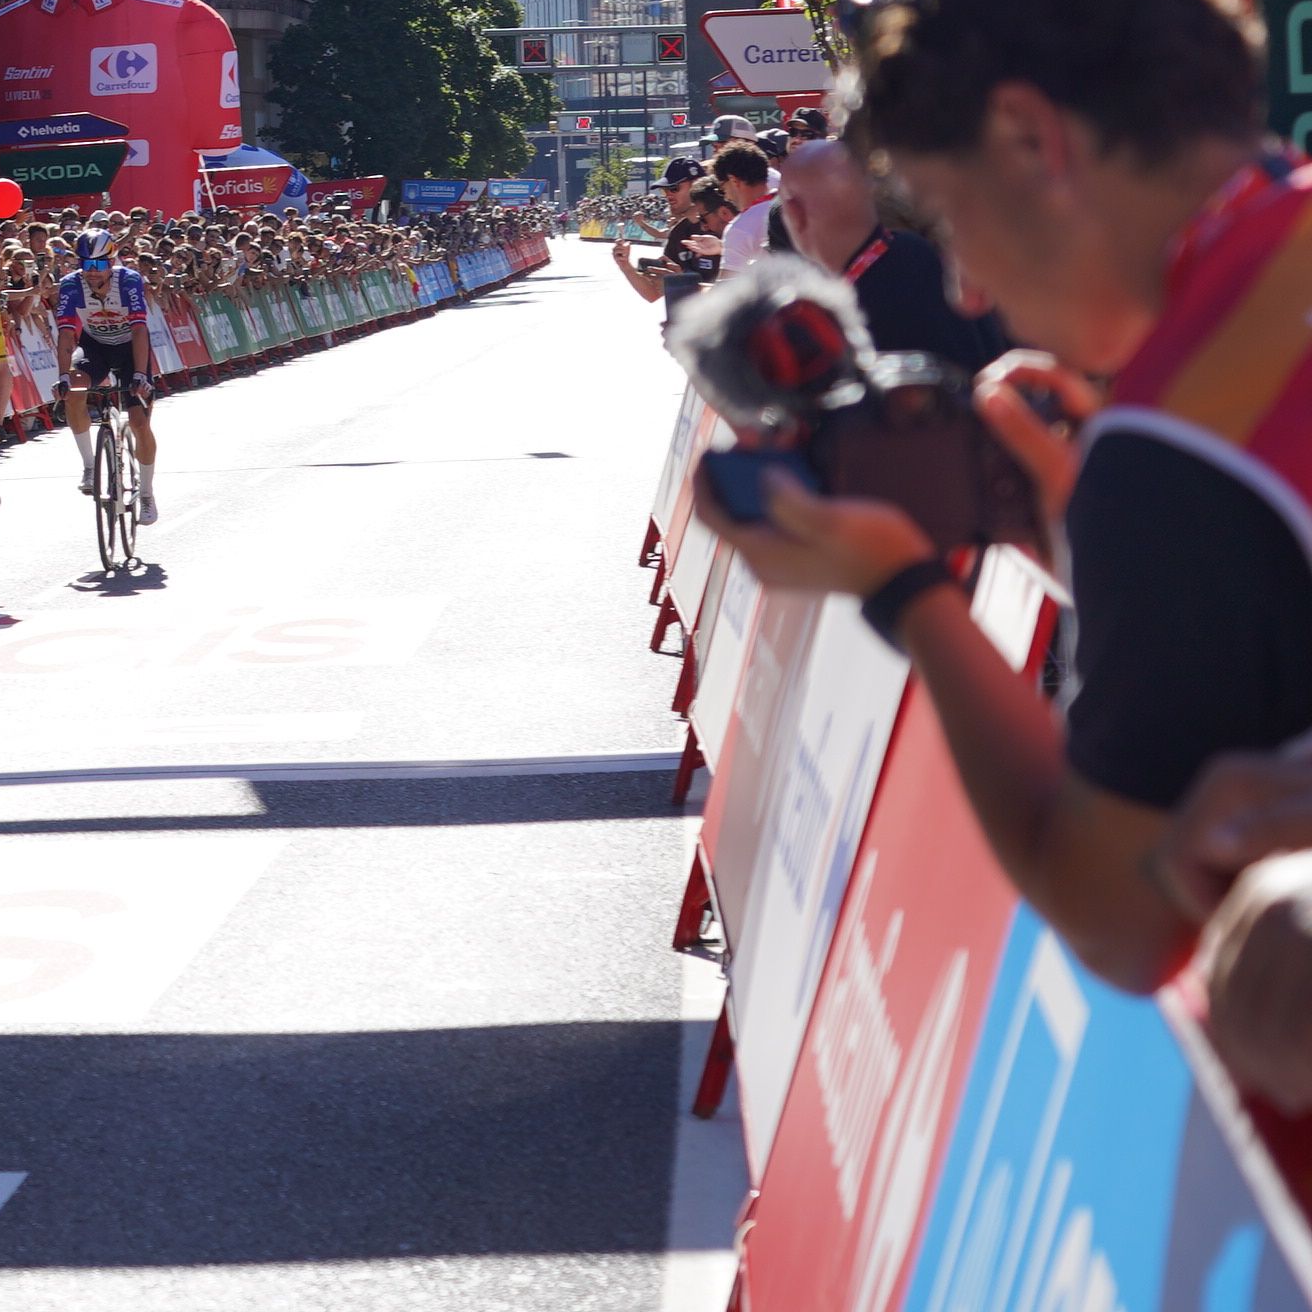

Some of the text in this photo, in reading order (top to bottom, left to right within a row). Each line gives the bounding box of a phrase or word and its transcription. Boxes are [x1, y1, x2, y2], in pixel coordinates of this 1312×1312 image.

[3, 65, 55, 81] Santini
[96, 80, 151, 92] Carrefour
[12, 90, 41, 102] VUELTA
[30, 122, 80, 137] helvetia
[200, 179, 263, 196] Cofidis
[127, 288, 142, 311] BOSS
